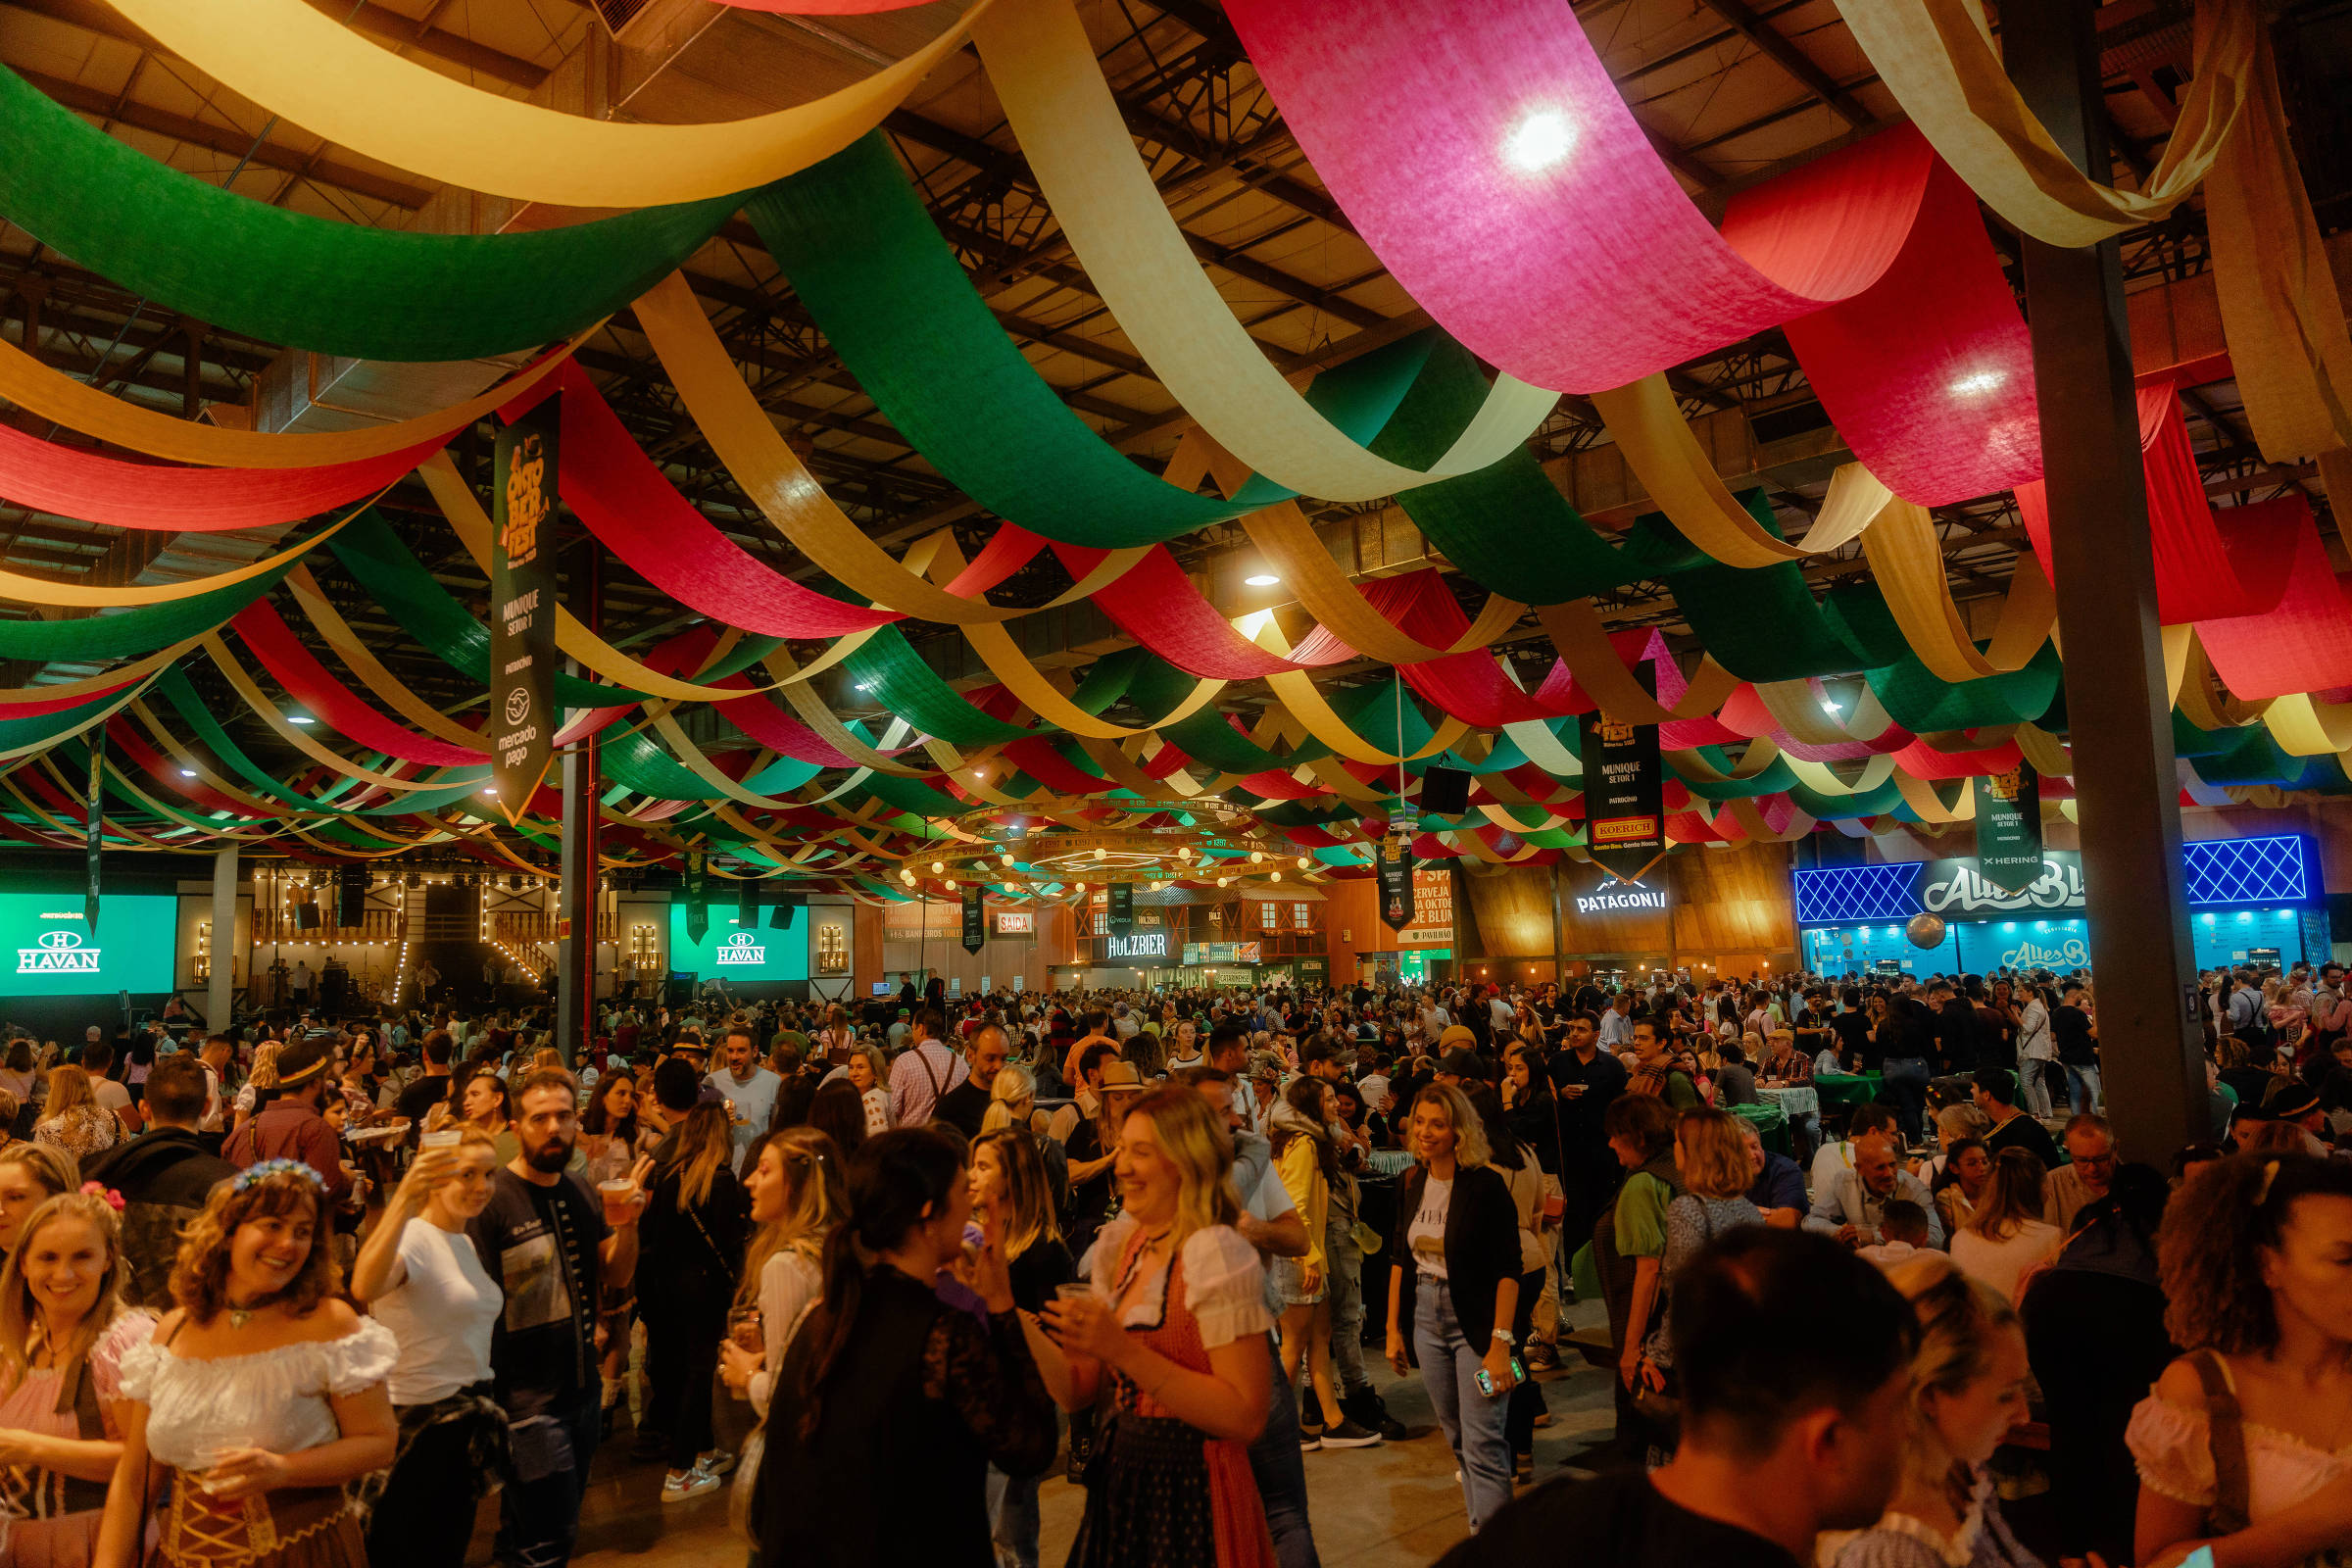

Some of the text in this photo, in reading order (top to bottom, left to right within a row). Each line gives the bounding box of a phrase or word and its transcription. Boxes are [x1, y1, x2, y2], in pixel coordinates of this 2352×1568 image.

[503, 588, 540, 622] MUNIQUE
[508, 613, 533, 637] SETOR 1
[498, 724, 537, 752] mercado
[505, 746, 528, 769] pago
[1601, 760, 1642, 776] MUNIQUE
[1608, 773, 1636, 784] SETOR 1
[1991, 812, 2023, 822] MUNIQUE
[1412, 910, 1425, 924] DE
[52, 933, 69, 948] H
[737, 936, 746, 946] H
[1107, 934, 1166, 958] HOLZBIER
[18, 953, 100, 969] HAVAN
[717, 950, 765, 962] HAVAN
[2002, 941, 2066, 967] Alles
